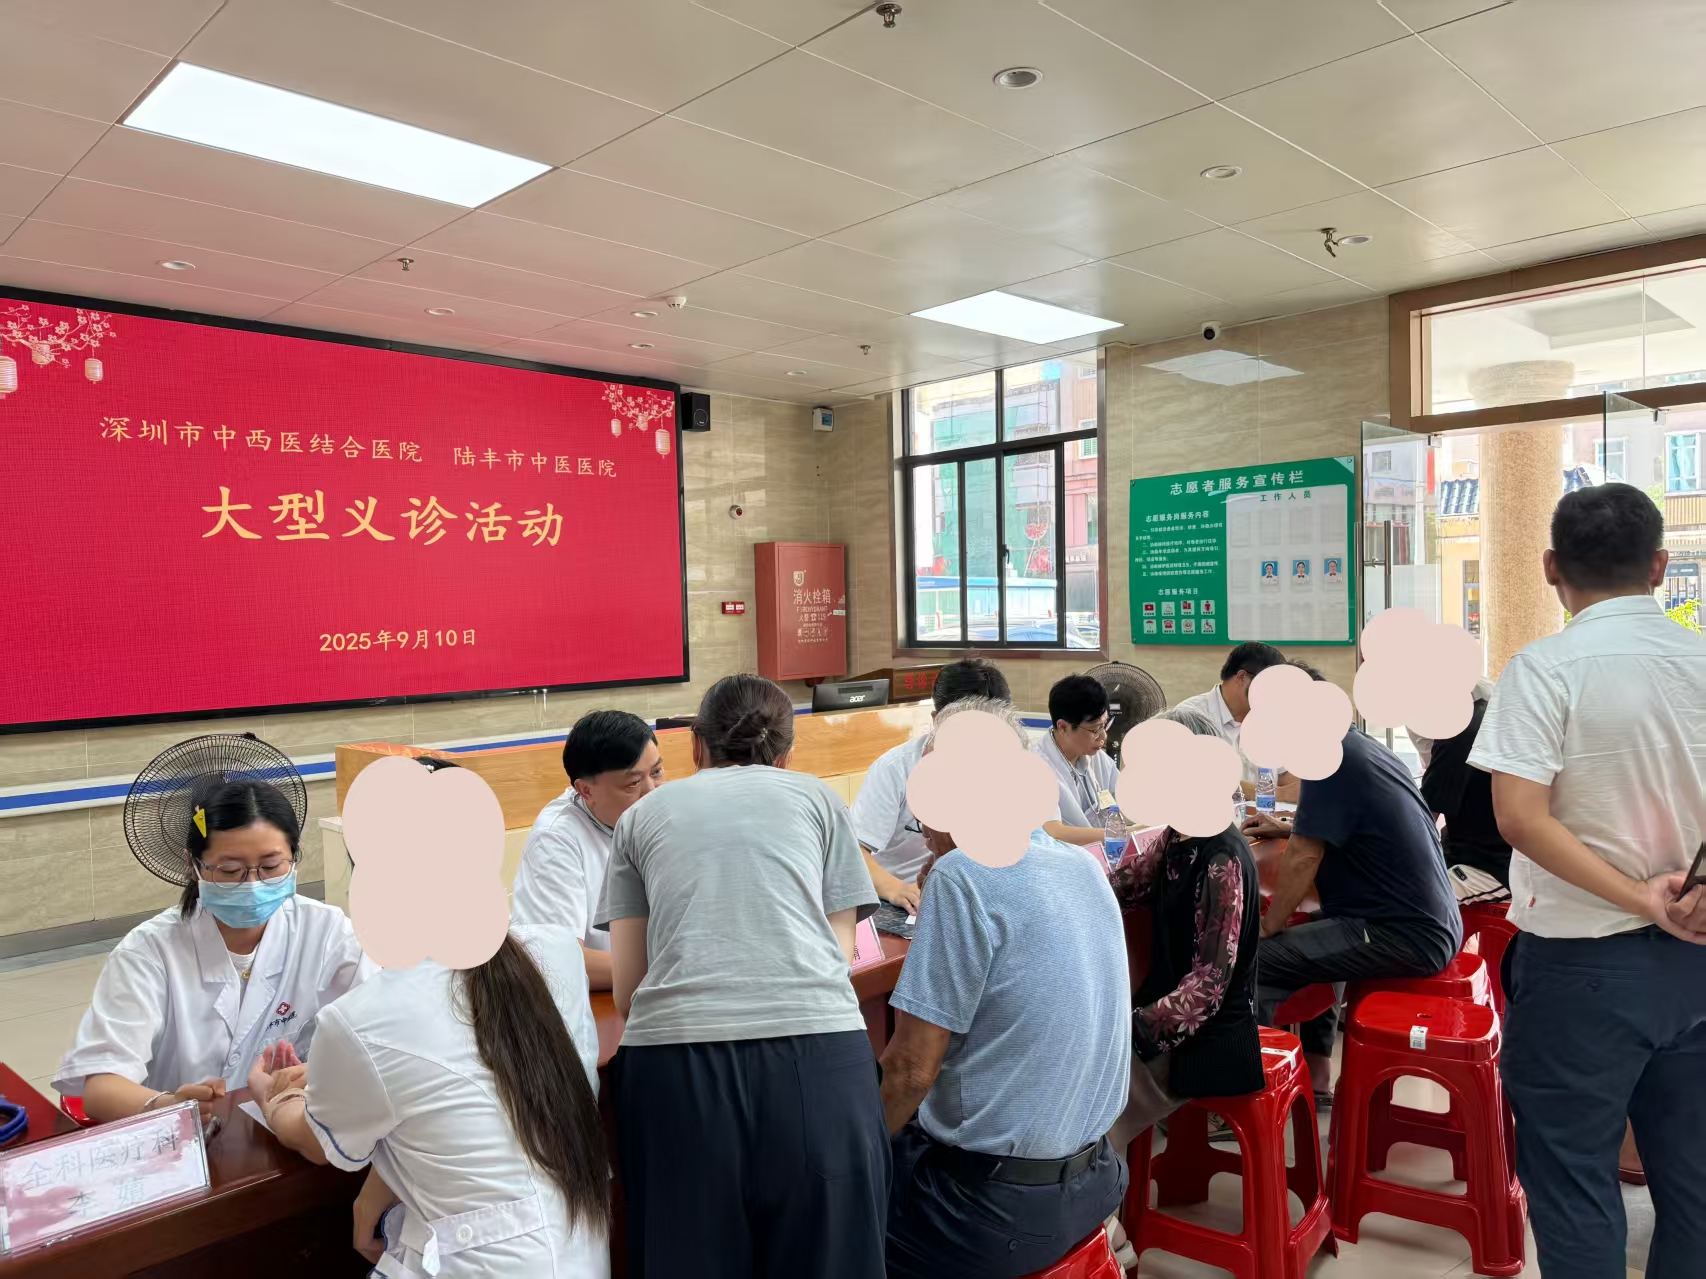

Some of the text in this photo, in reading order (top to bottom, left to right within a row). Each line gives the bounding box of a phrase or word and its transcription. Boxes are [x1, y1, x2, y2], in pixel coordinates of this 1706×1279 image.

[99, 415, 618, 479] 深圳市中西医结合医院 陆丰市中医医院
[1170, 470, 1305, 496] 志愿者服务宣传栏
[1260, 490, 1312, 502] 工作人员
[200, 485, 564, 548] 大型义诊活动
[793, 588, 832, 606] 消火栓箱
[318, 628, 476, 653] 2025年9月10日
[849, 693, 866, 704] acer
[24, 1127, 179, 1190] 全科医疗科
